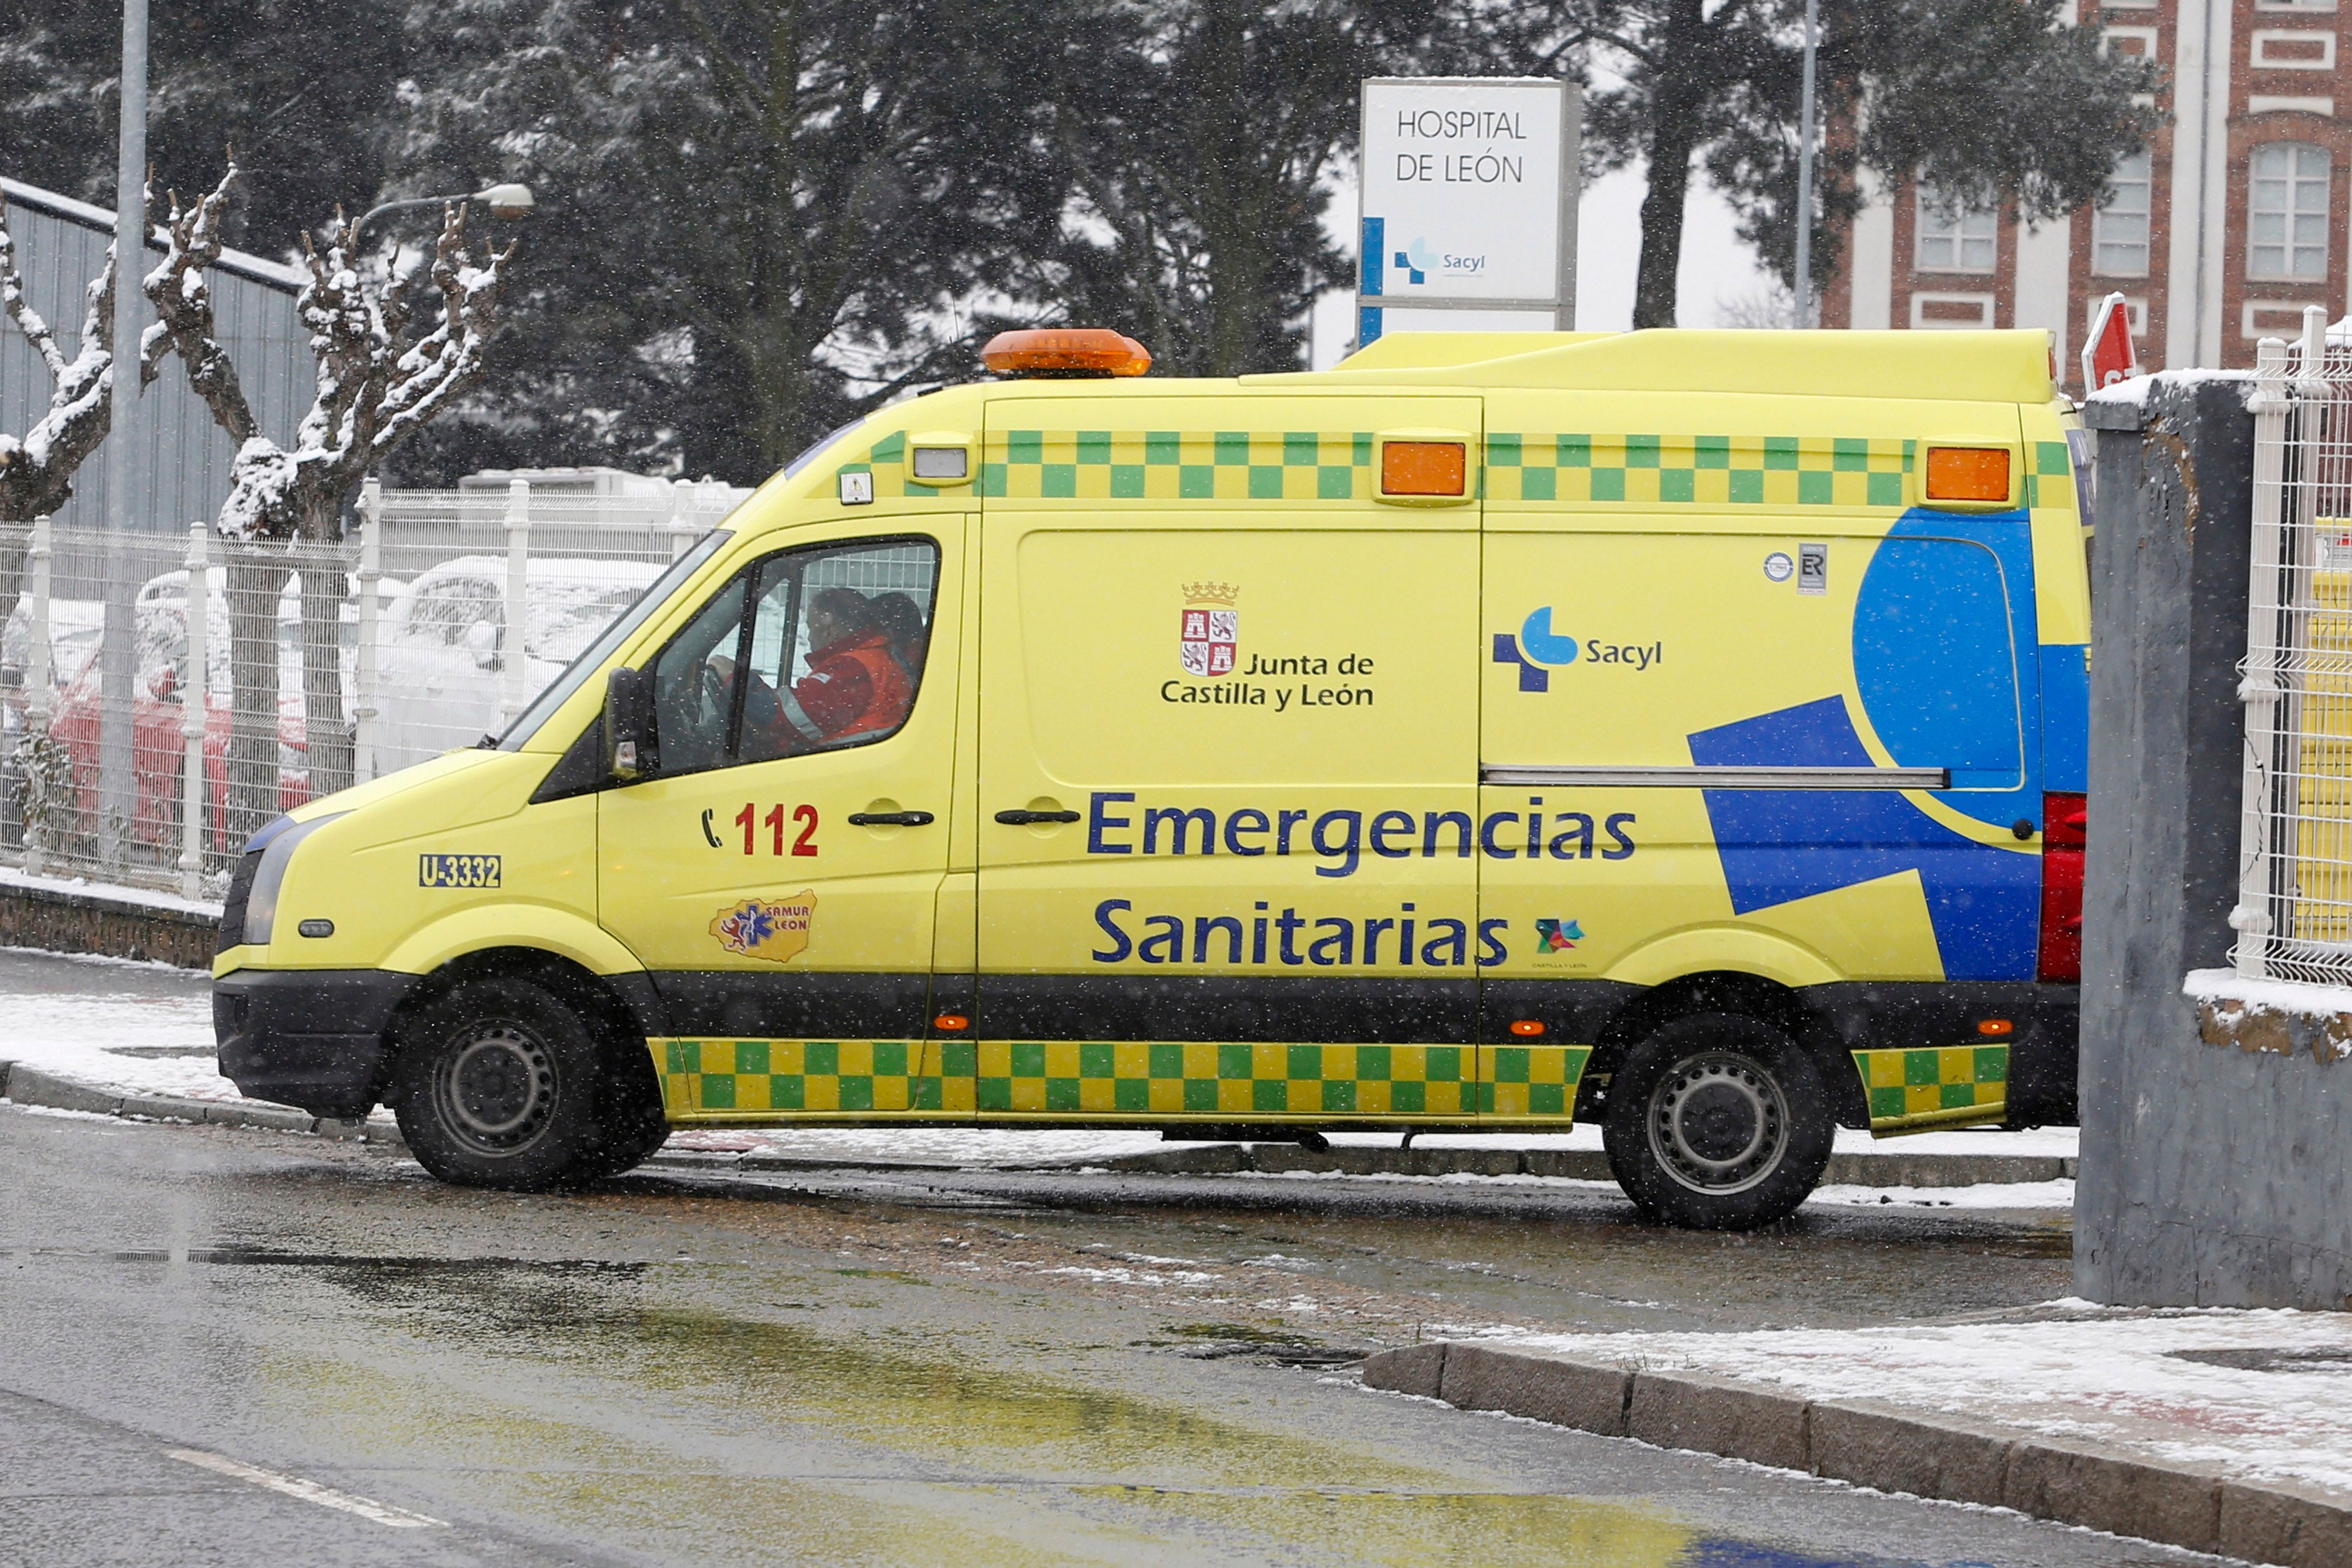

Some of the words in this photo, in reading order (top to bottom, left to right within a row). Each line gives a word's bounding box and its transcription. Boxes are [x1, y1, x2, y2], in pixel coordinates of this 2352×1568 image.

[1398, 110, 1527, 140] HOSPITAL
[1397, 154, 1433, 182] DE
[1445, 147, 1522, 183] LEÓN
[1443, 254, 1485, 272] Sacyl
[1243, 654, 1327, 675] Junta
[1337, 654, 1374, 675] de
[1586, 640, 1661, 671] Sacyl
[1161, 680, 1265, 705] Castilla
[1274, 689, 1292, 712] y
[1301, 684, 1373, 706] León
[735, 802, 819, 857] 112
[1086, 792, 1636, 878] Emergencias
[421, 856, 499, 887] U-3332
[766, 906, 809, 917] SAMUR
[774, 920, 807, 930] LEON
[1091, 898, 1509, 967] Sanitarias
